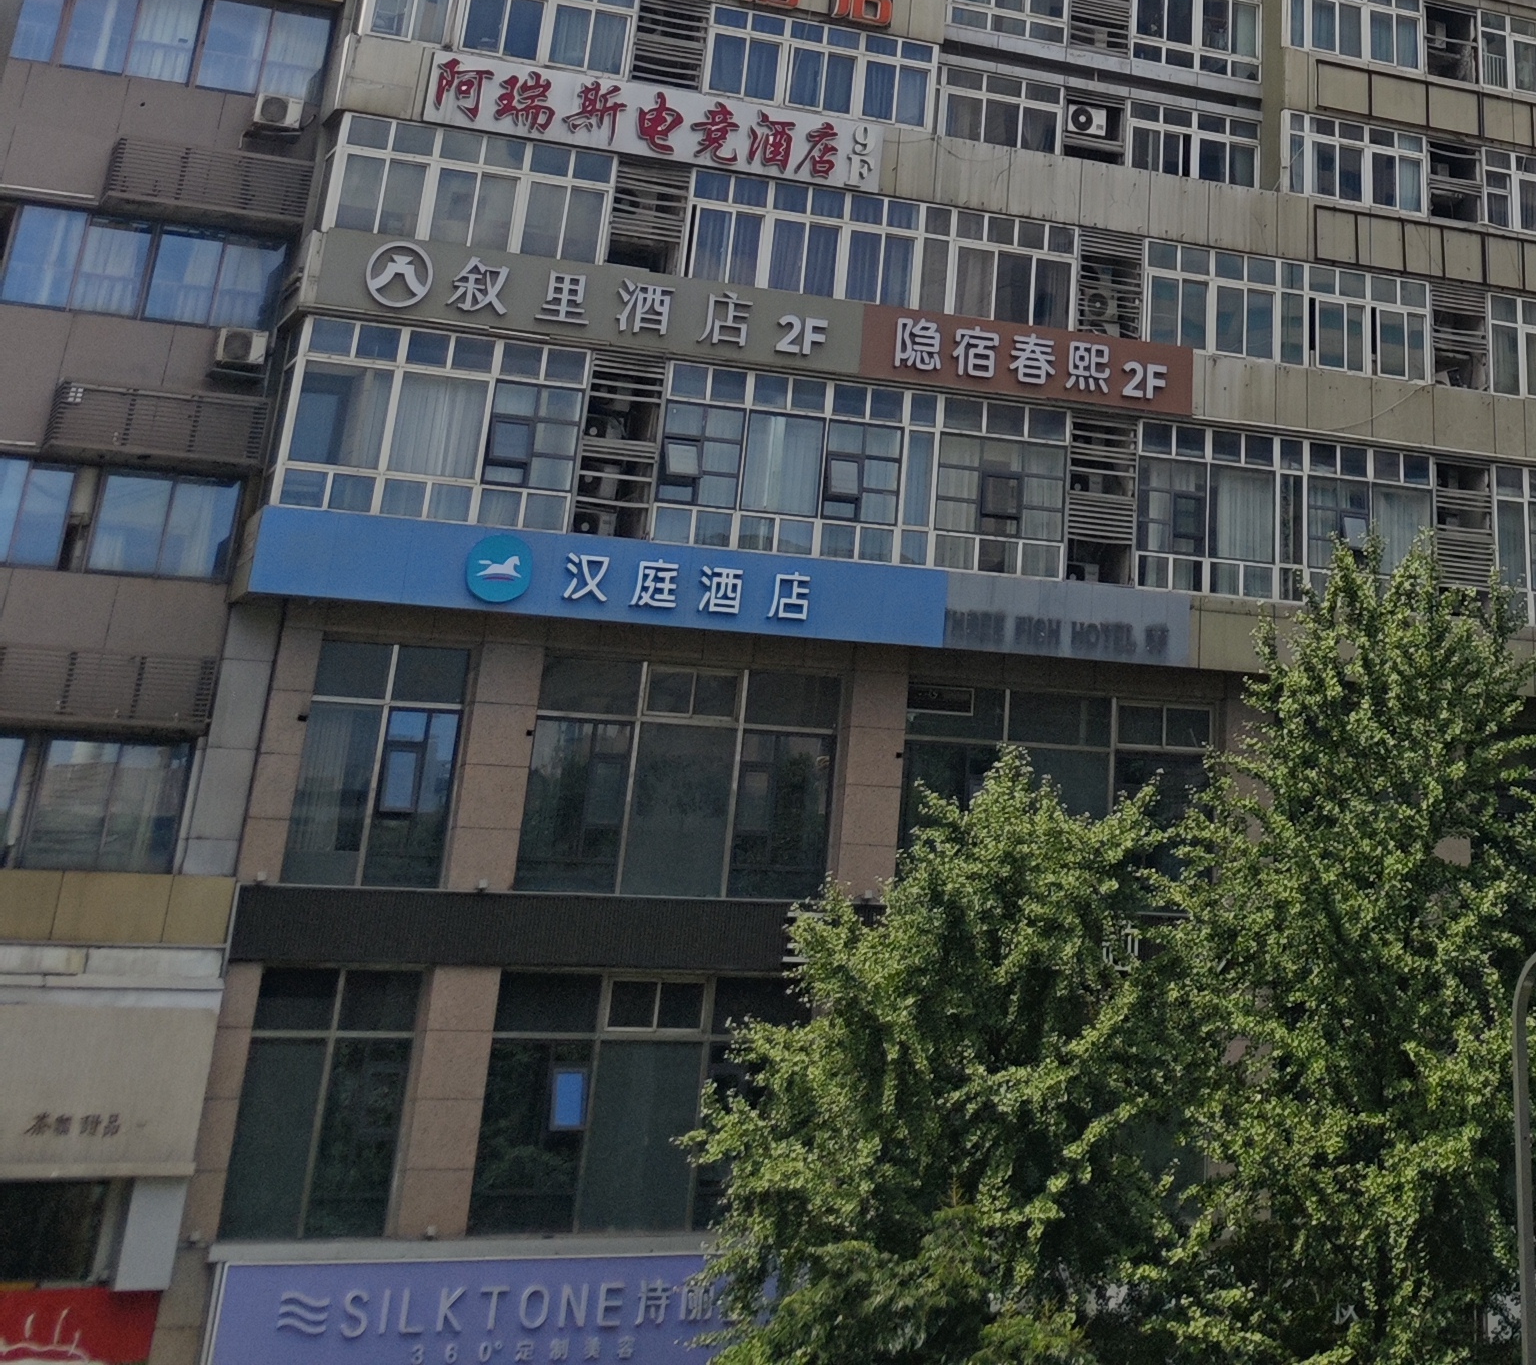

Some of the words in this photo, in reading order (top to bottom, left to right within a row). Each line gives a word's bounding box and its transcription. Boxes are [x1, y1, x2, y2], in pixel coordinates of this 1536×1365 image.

[433, 57, 839, 179] 阿瑞斯电竞酒店
[562, 552, 812, 621] 汉庭酒店
[339, 1282, 626, 1339] SILKTONE
